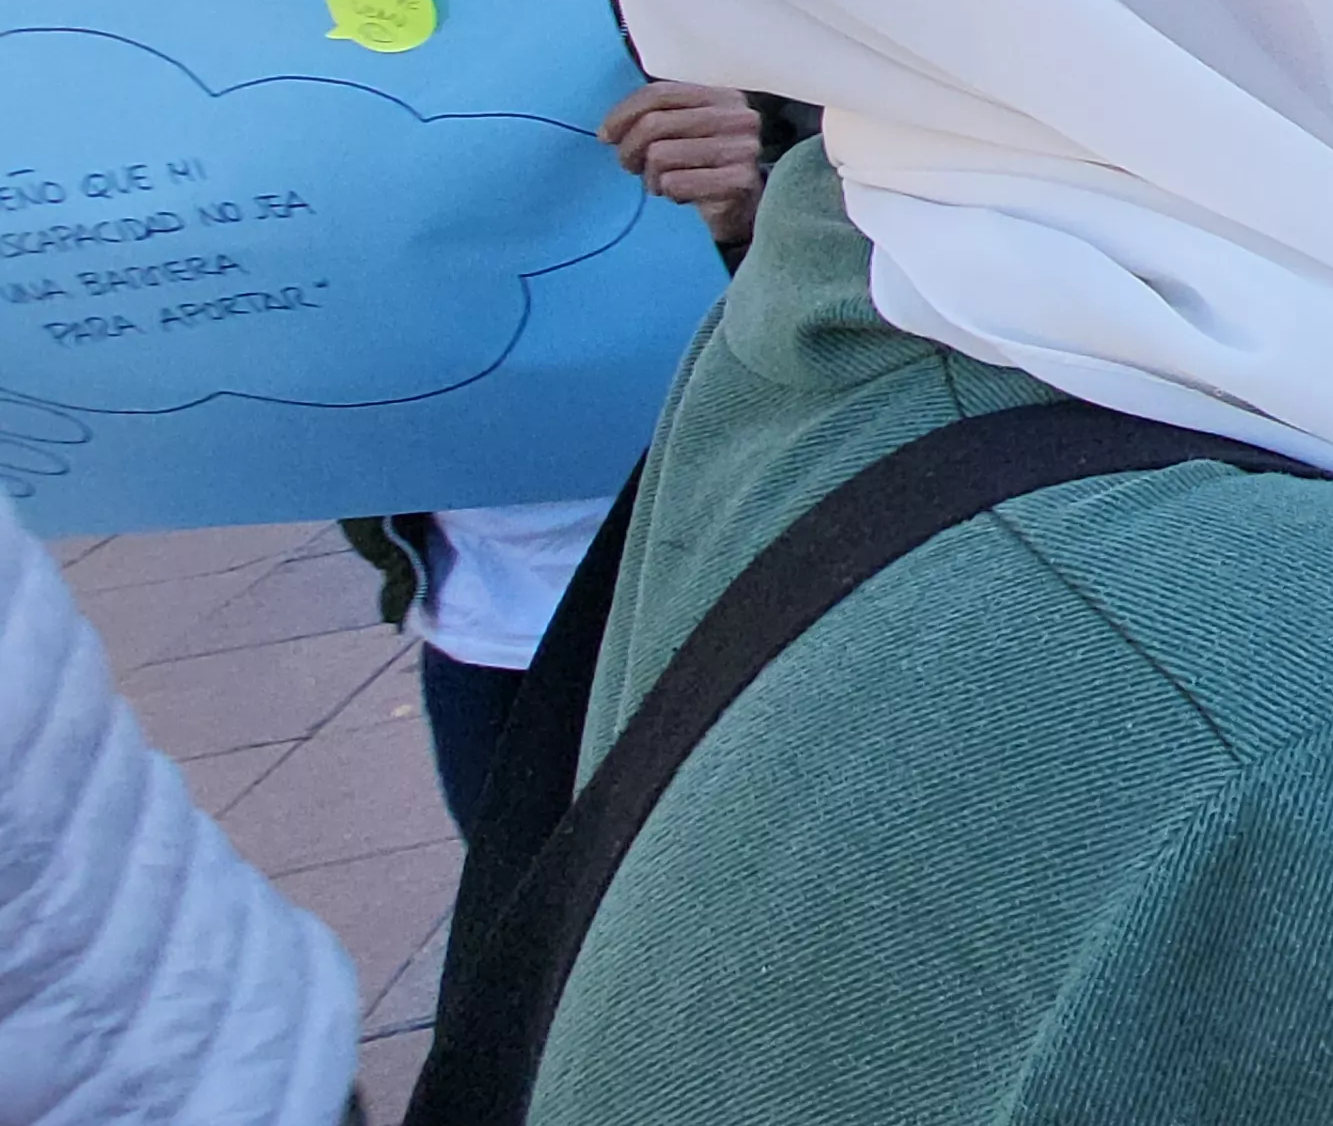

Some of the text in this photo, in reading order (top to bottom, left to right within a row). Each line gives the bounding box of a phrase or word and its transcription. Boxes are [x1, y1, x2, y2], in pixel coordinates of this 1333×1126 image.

[80, 164, 154, 199] QUE
[166, 159, 207, 184] MI
[196, 201, 244, 227] NO
[252, 190, 318, 220] SEA
[75, 254, 251, 296] BARRERA
[43, 316, 147, 348] PARA
